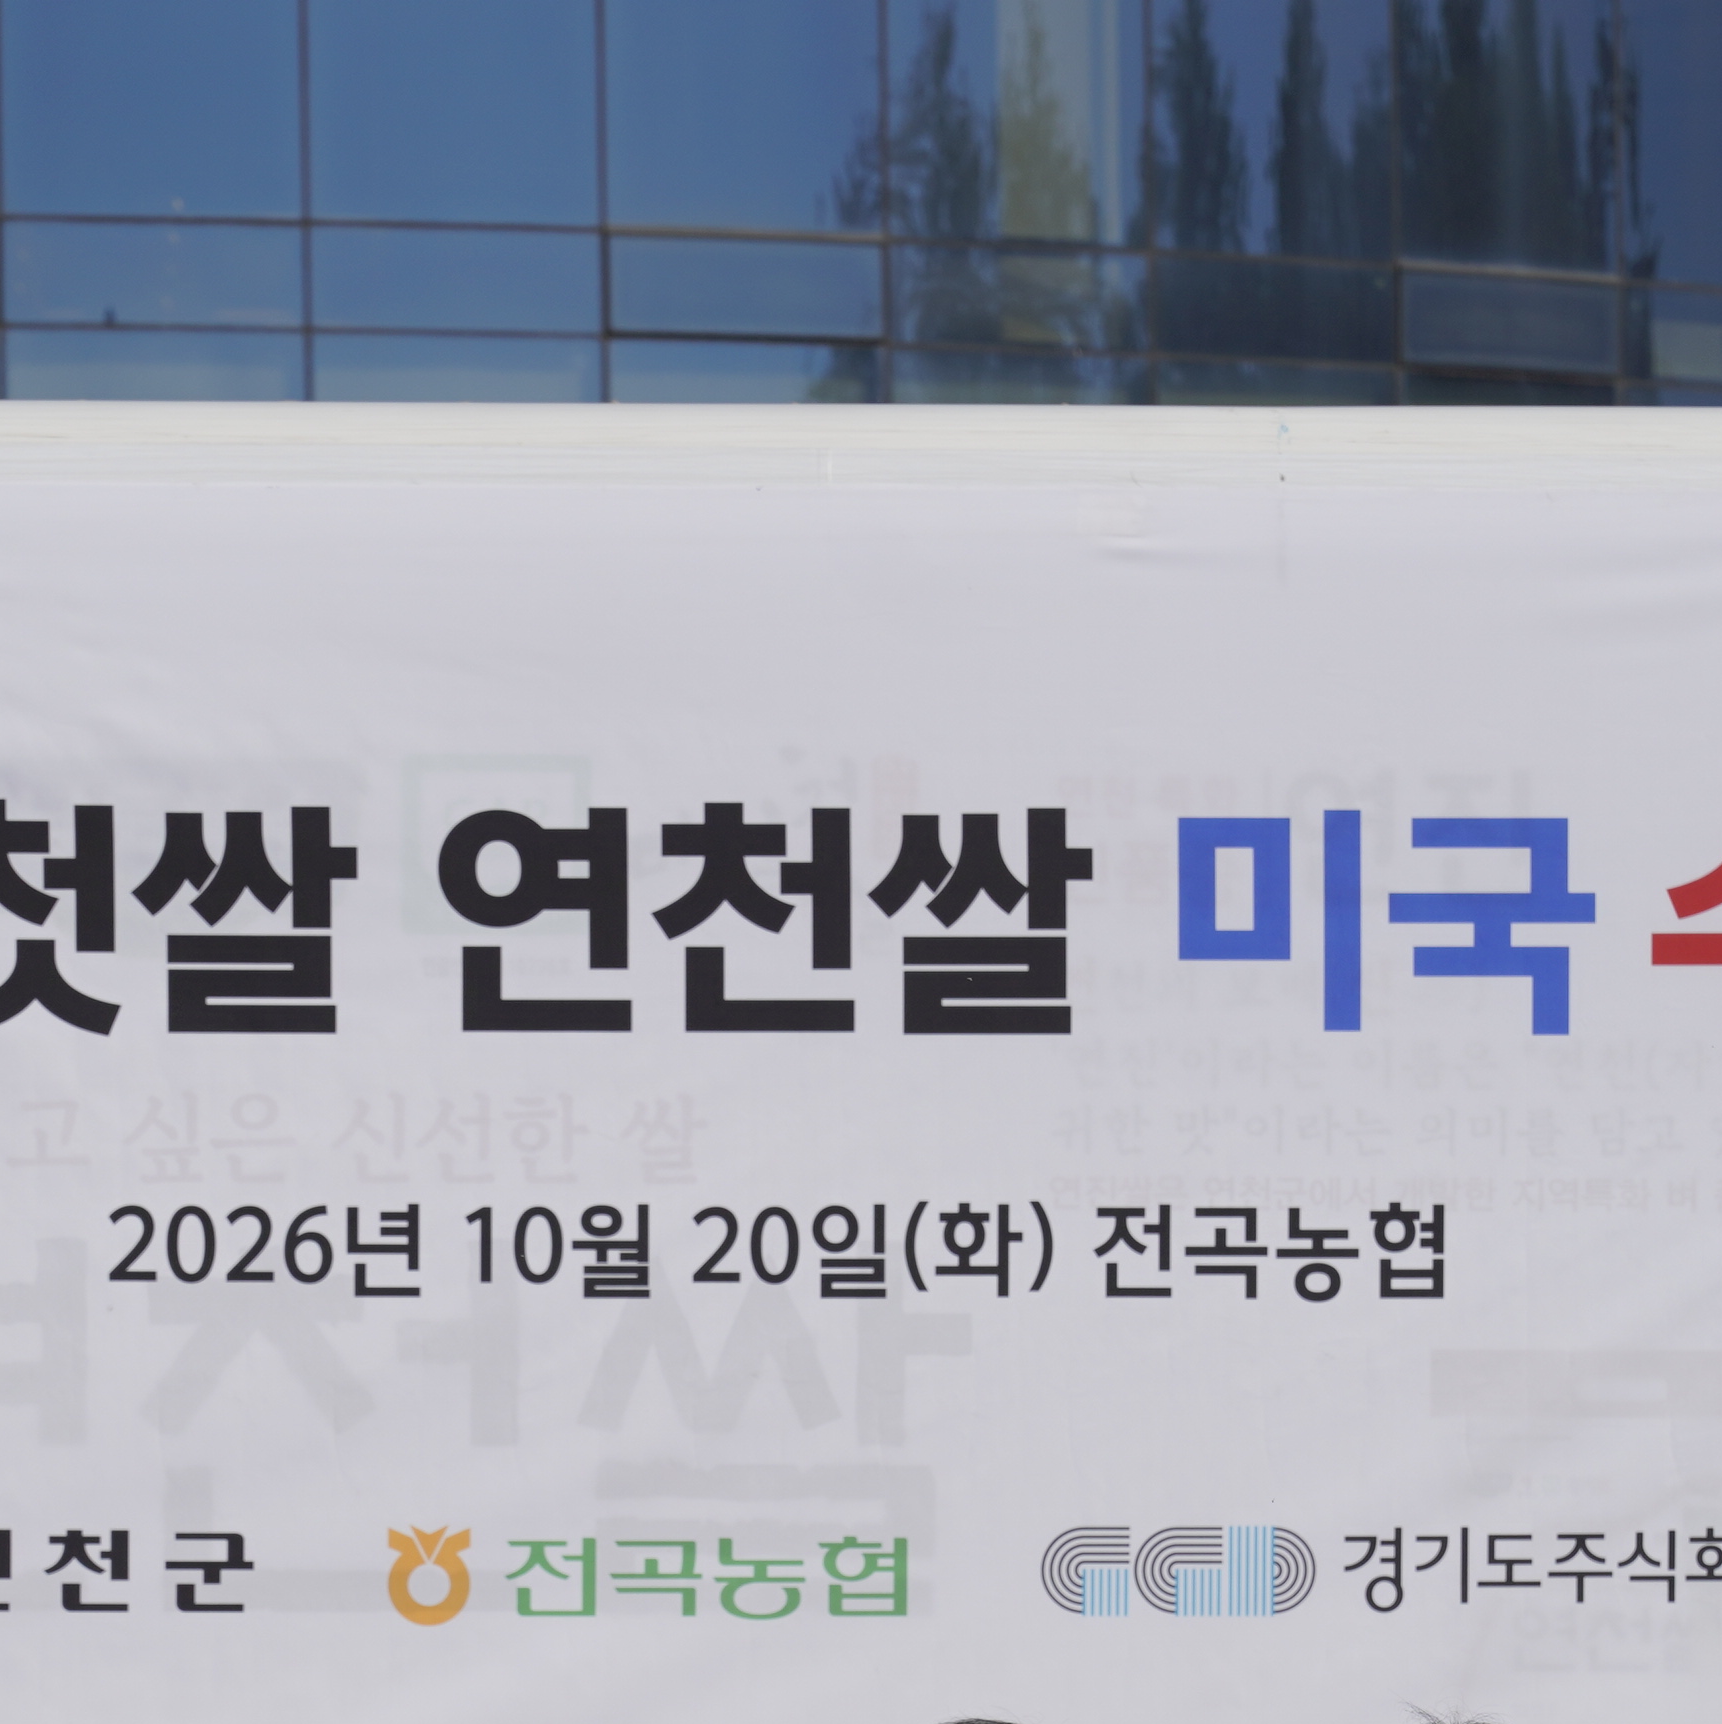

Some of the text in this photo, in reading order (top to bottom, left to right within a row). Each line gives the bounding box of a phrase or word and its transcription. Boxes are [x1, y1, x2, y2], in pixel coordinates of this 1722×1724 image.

[436, 801, 1091, 1035] 연천쌀
[1177, 808, 1596, 1035] 미국
[107, 1196, 1448, 1302] 2026년 10월 20일(화) 전곡농협
[503, 1533, 911, 1620] 전곡농협
